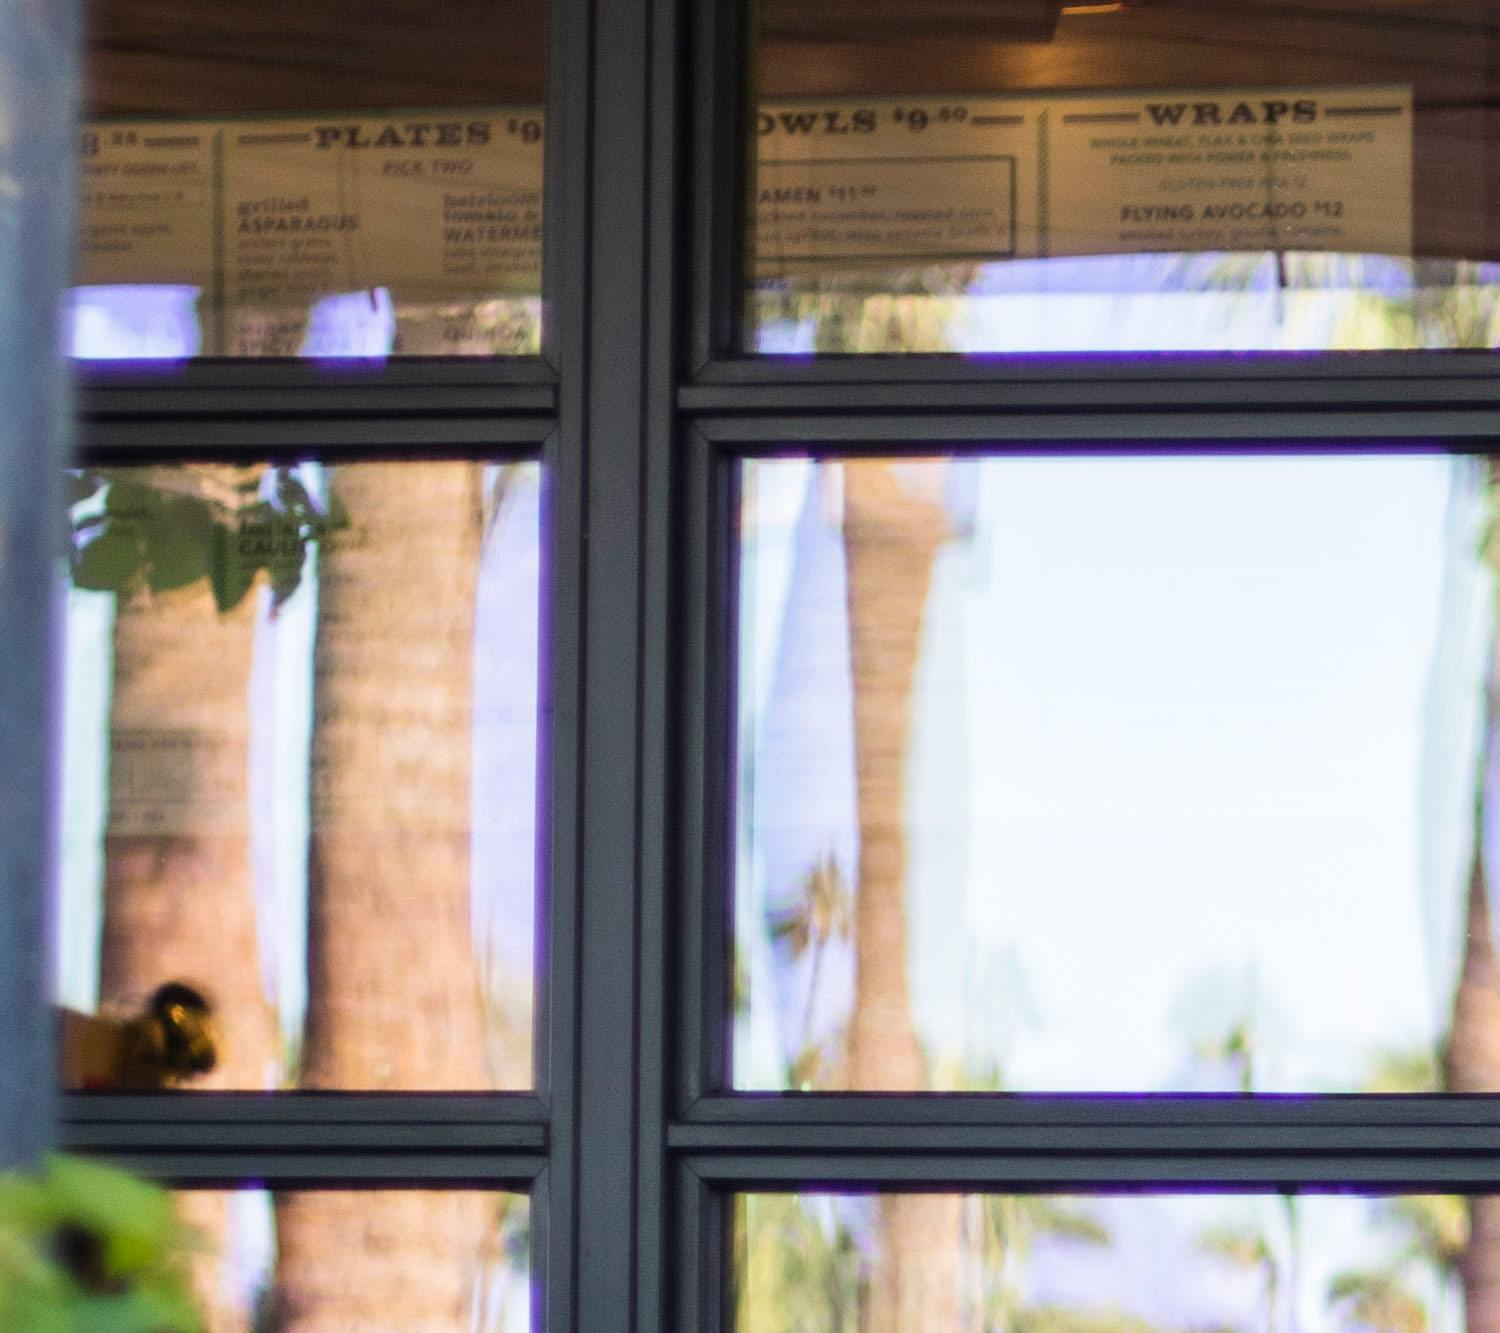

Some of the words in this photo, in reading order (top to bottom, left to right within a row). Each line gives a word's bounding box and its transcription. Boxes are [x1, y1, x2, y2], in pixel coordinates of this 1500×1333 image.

[1145, 100, 1318, 126] WRAPS
[315, 122, 490, 149] PLATES
[237, 198, 309, 215] grilled
[1121, 204, 1195, 221] FLYING
[1202, 201, 1306, 220] AVOCADO
[237, 214, 360, 233] ASPARAGUS
